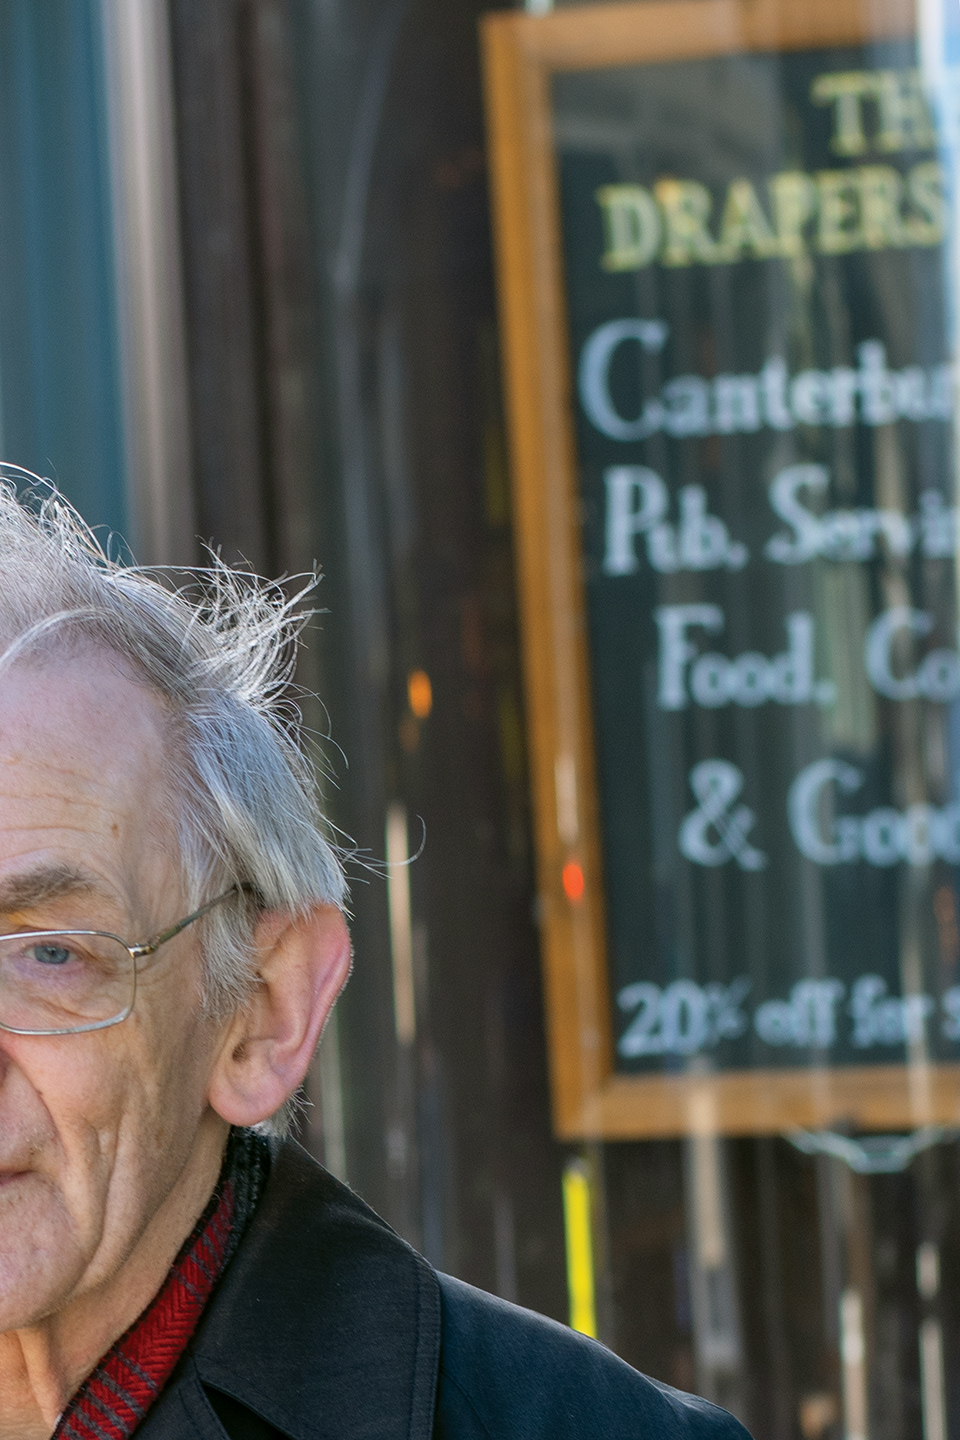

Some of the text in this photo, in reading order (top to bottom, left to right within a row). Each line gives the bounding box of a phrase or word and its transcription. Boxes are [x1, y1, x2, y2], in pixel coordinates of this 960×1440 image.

[596, 162, 949, 272] DRAPERS
[765, 463, 959, 565] Servi
[655, 602, 837, 710] Food.
[679, 759, 767, 871] &
[754, 977, 845, 1049] off
[850, 972, 936, 1048] for
